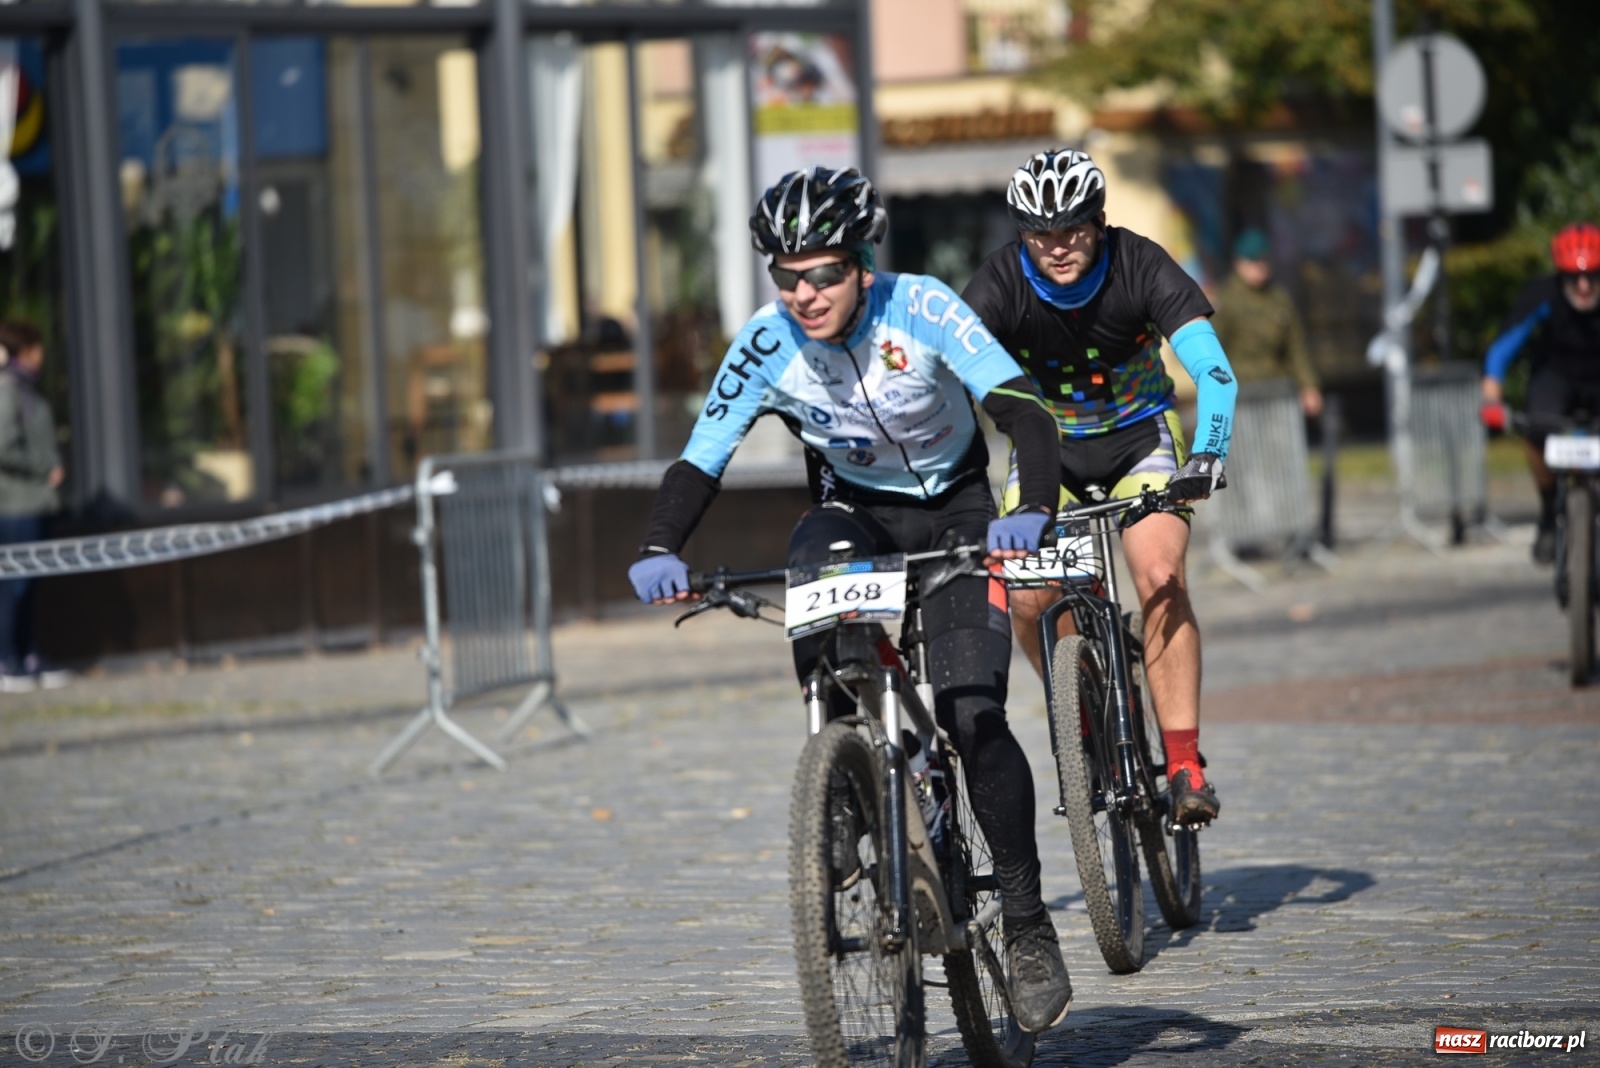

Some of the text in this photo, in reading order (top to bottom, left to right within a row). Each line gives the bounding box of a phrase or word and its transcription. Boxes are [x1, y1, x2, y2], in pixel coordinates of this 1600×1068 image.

[906, 284, 992, 355] SCHC
[706, 326, 781, 421] SCHC
[805, 582, 881, 612] 2168
